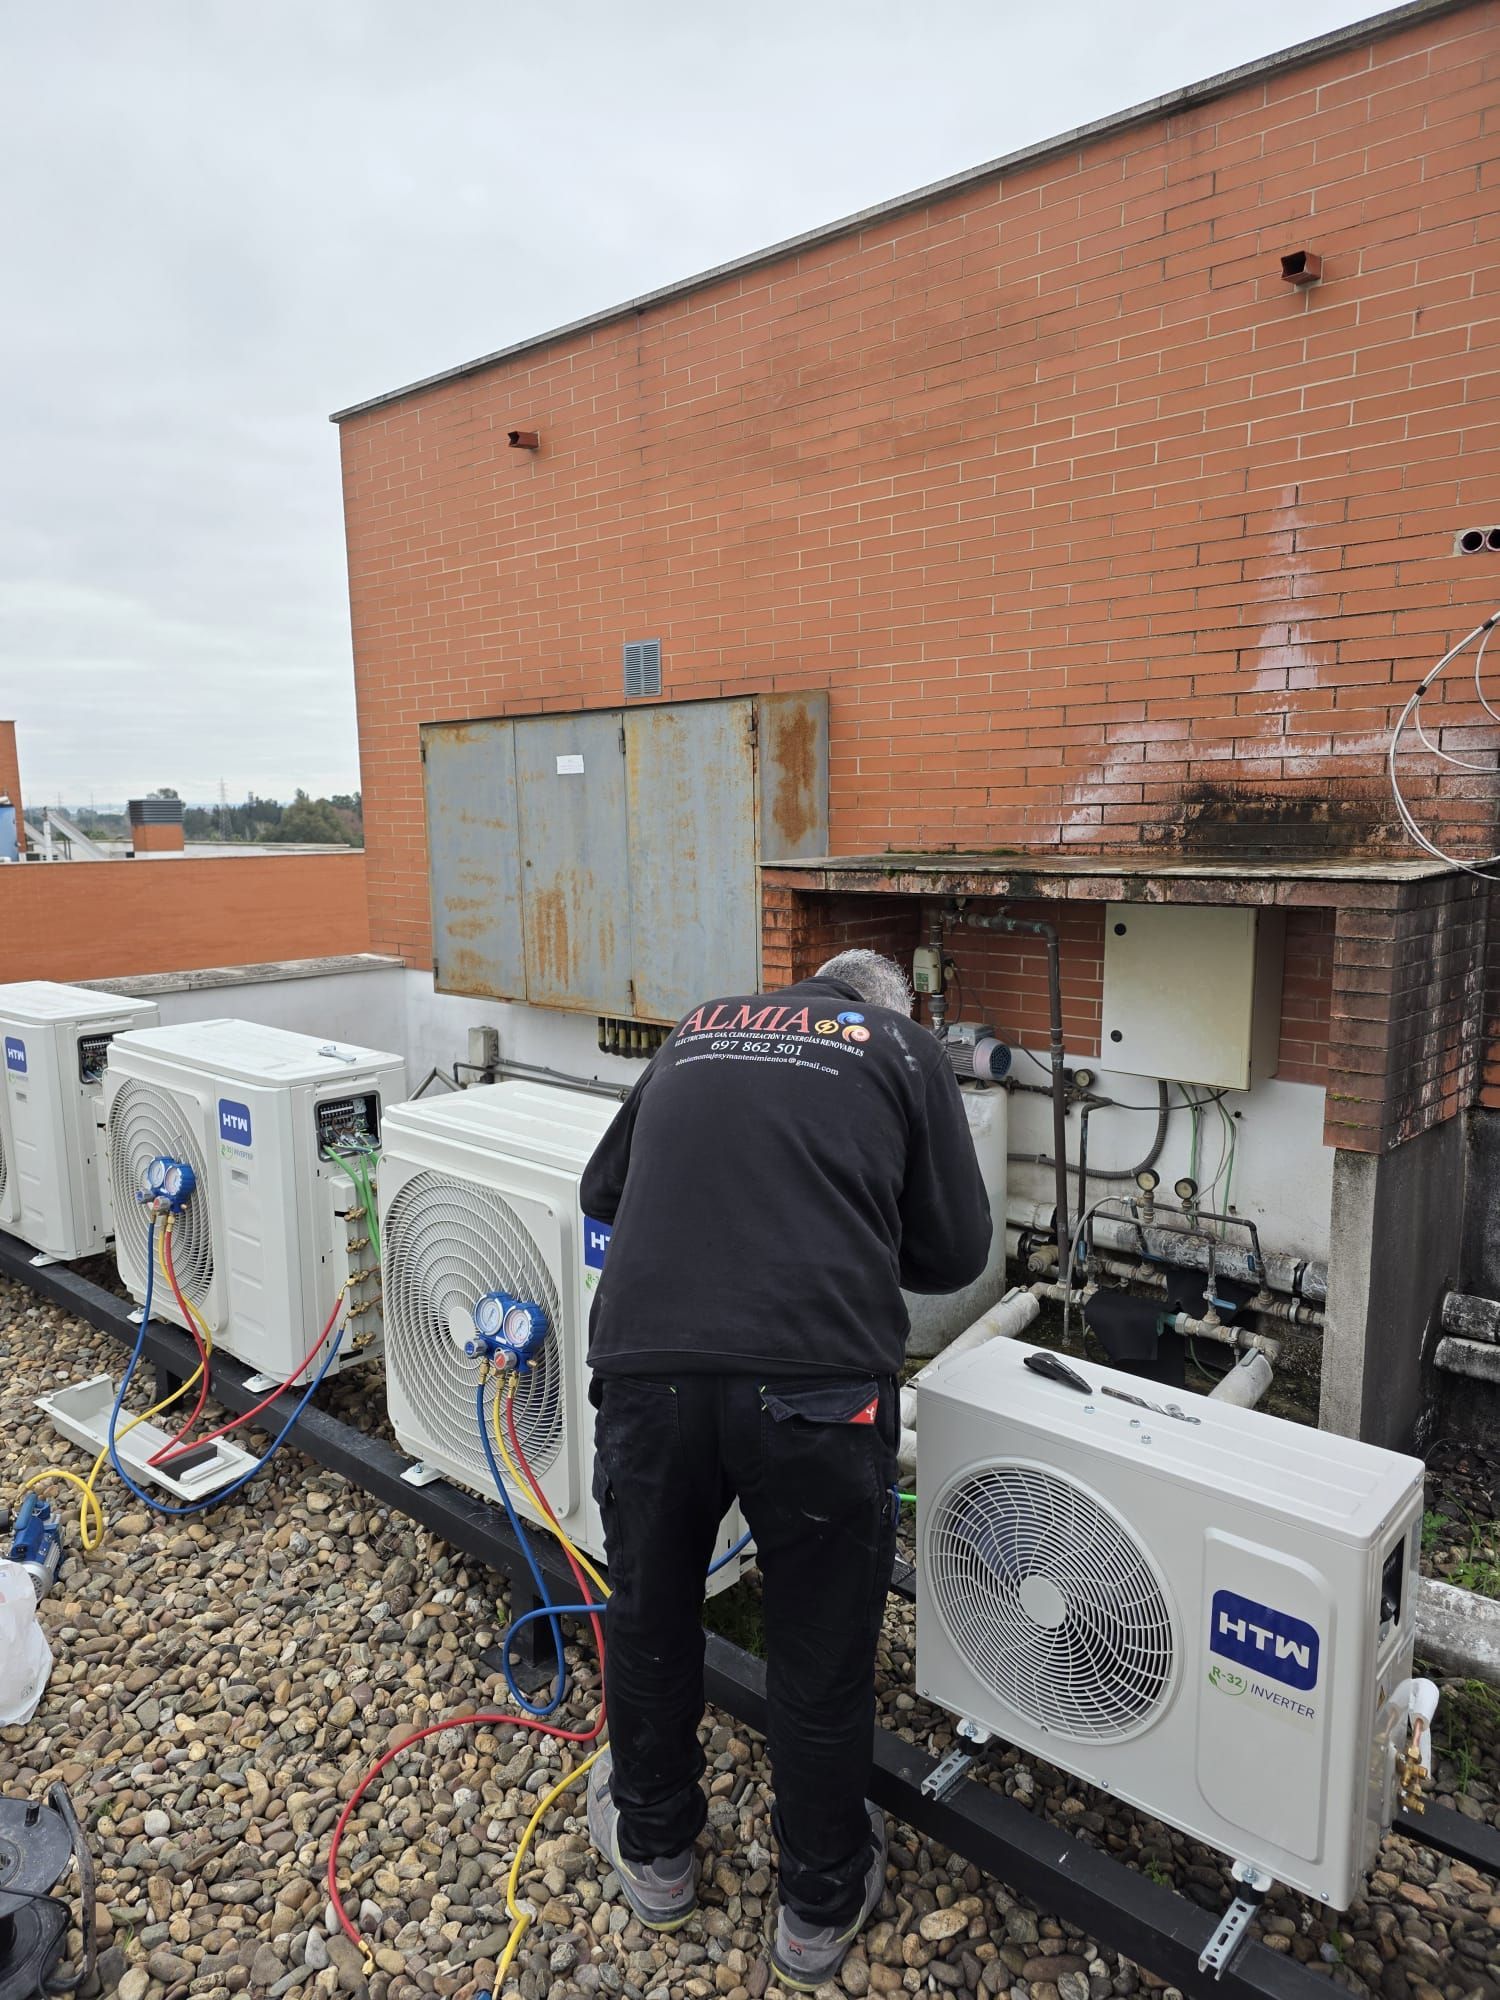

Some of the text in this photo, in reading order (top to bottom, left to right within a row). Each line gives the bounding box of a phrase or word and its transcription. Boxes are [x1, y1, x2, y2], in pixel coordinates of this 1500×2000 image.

[677, 1004, 810, 1037] ALMIA
[710, 1040, 803, 1056] 697 862 501
[786, 1034, 821, 1045] ENERGÍAS
[819, 1038, 865, 1057] RENOVABLES
[222, 1112, 248, 1133] HTW
[1218, 1610, 1310, 1670] HTW
[1211, 1665, 1316, 1720] R-32 INVERTER
